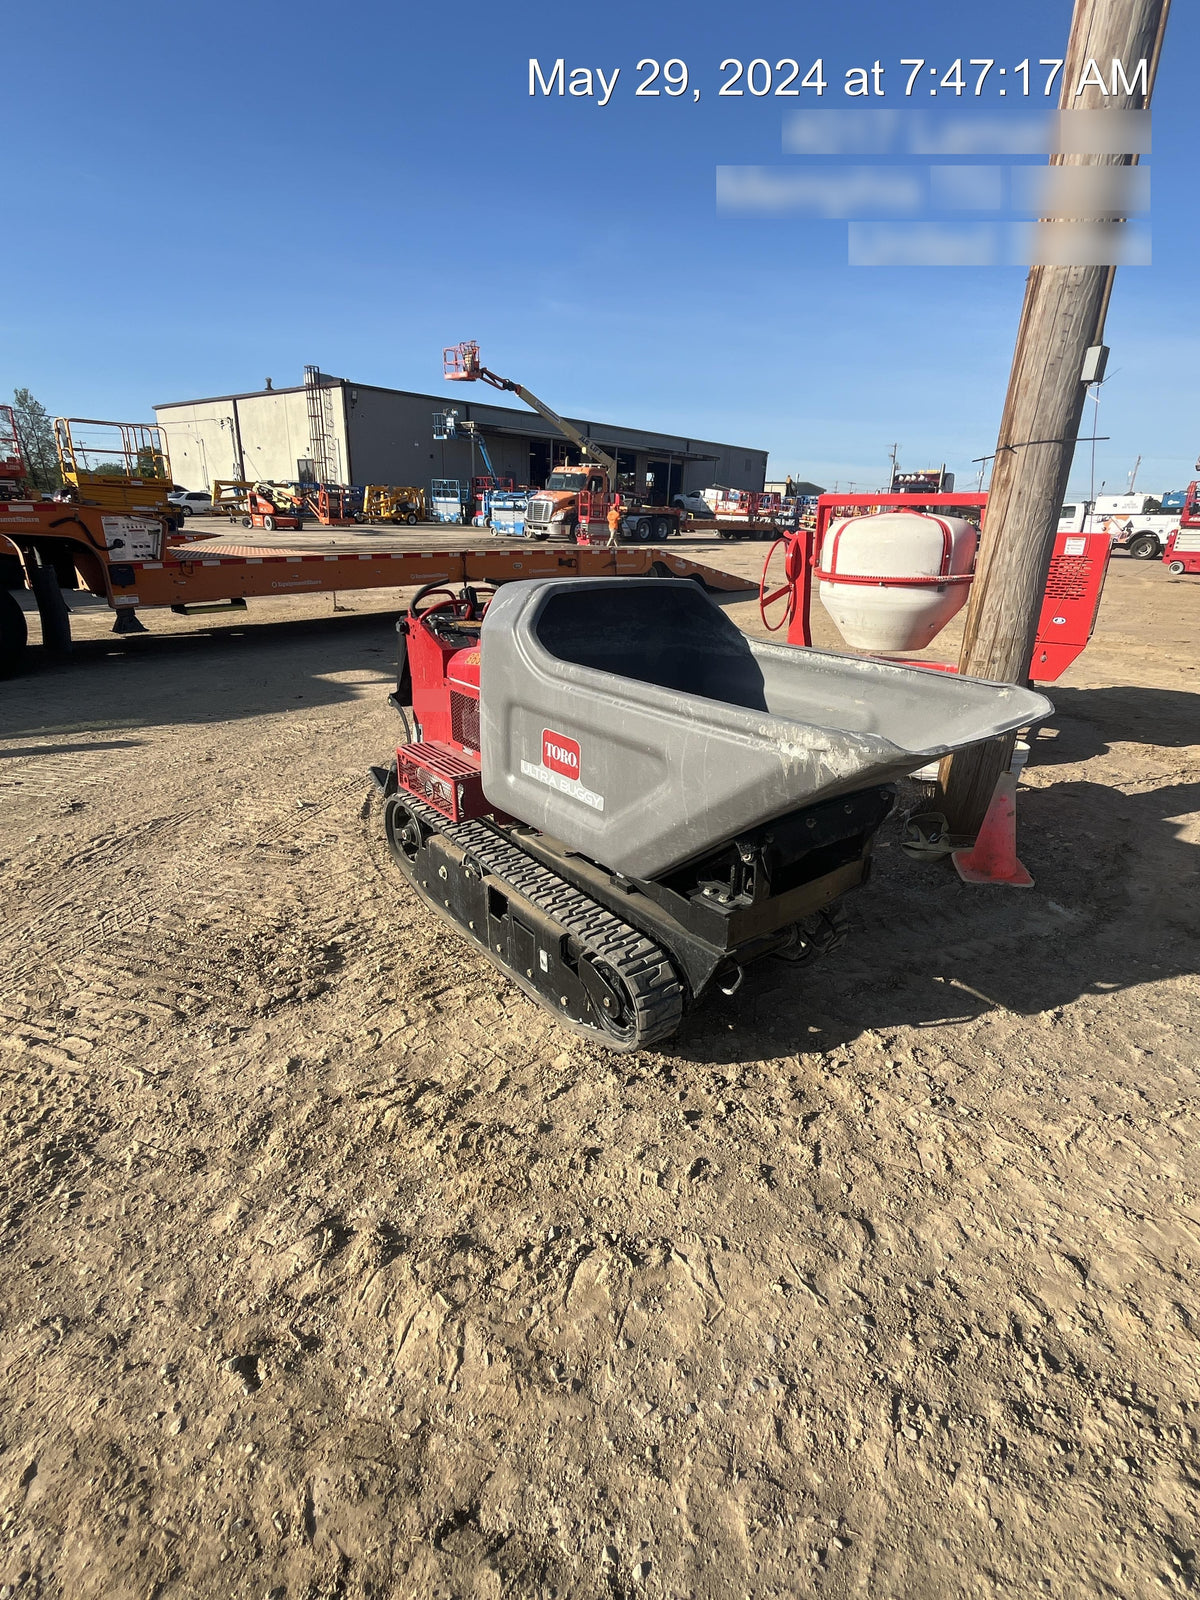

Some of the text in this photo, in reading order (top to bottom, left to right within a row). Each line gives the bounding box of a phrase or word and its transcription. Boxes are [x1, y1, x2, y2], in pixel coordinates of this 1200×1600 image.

[545, 741, 578, 768] TORO
[521, 763, 602, 808] ULTRA BUGGY
